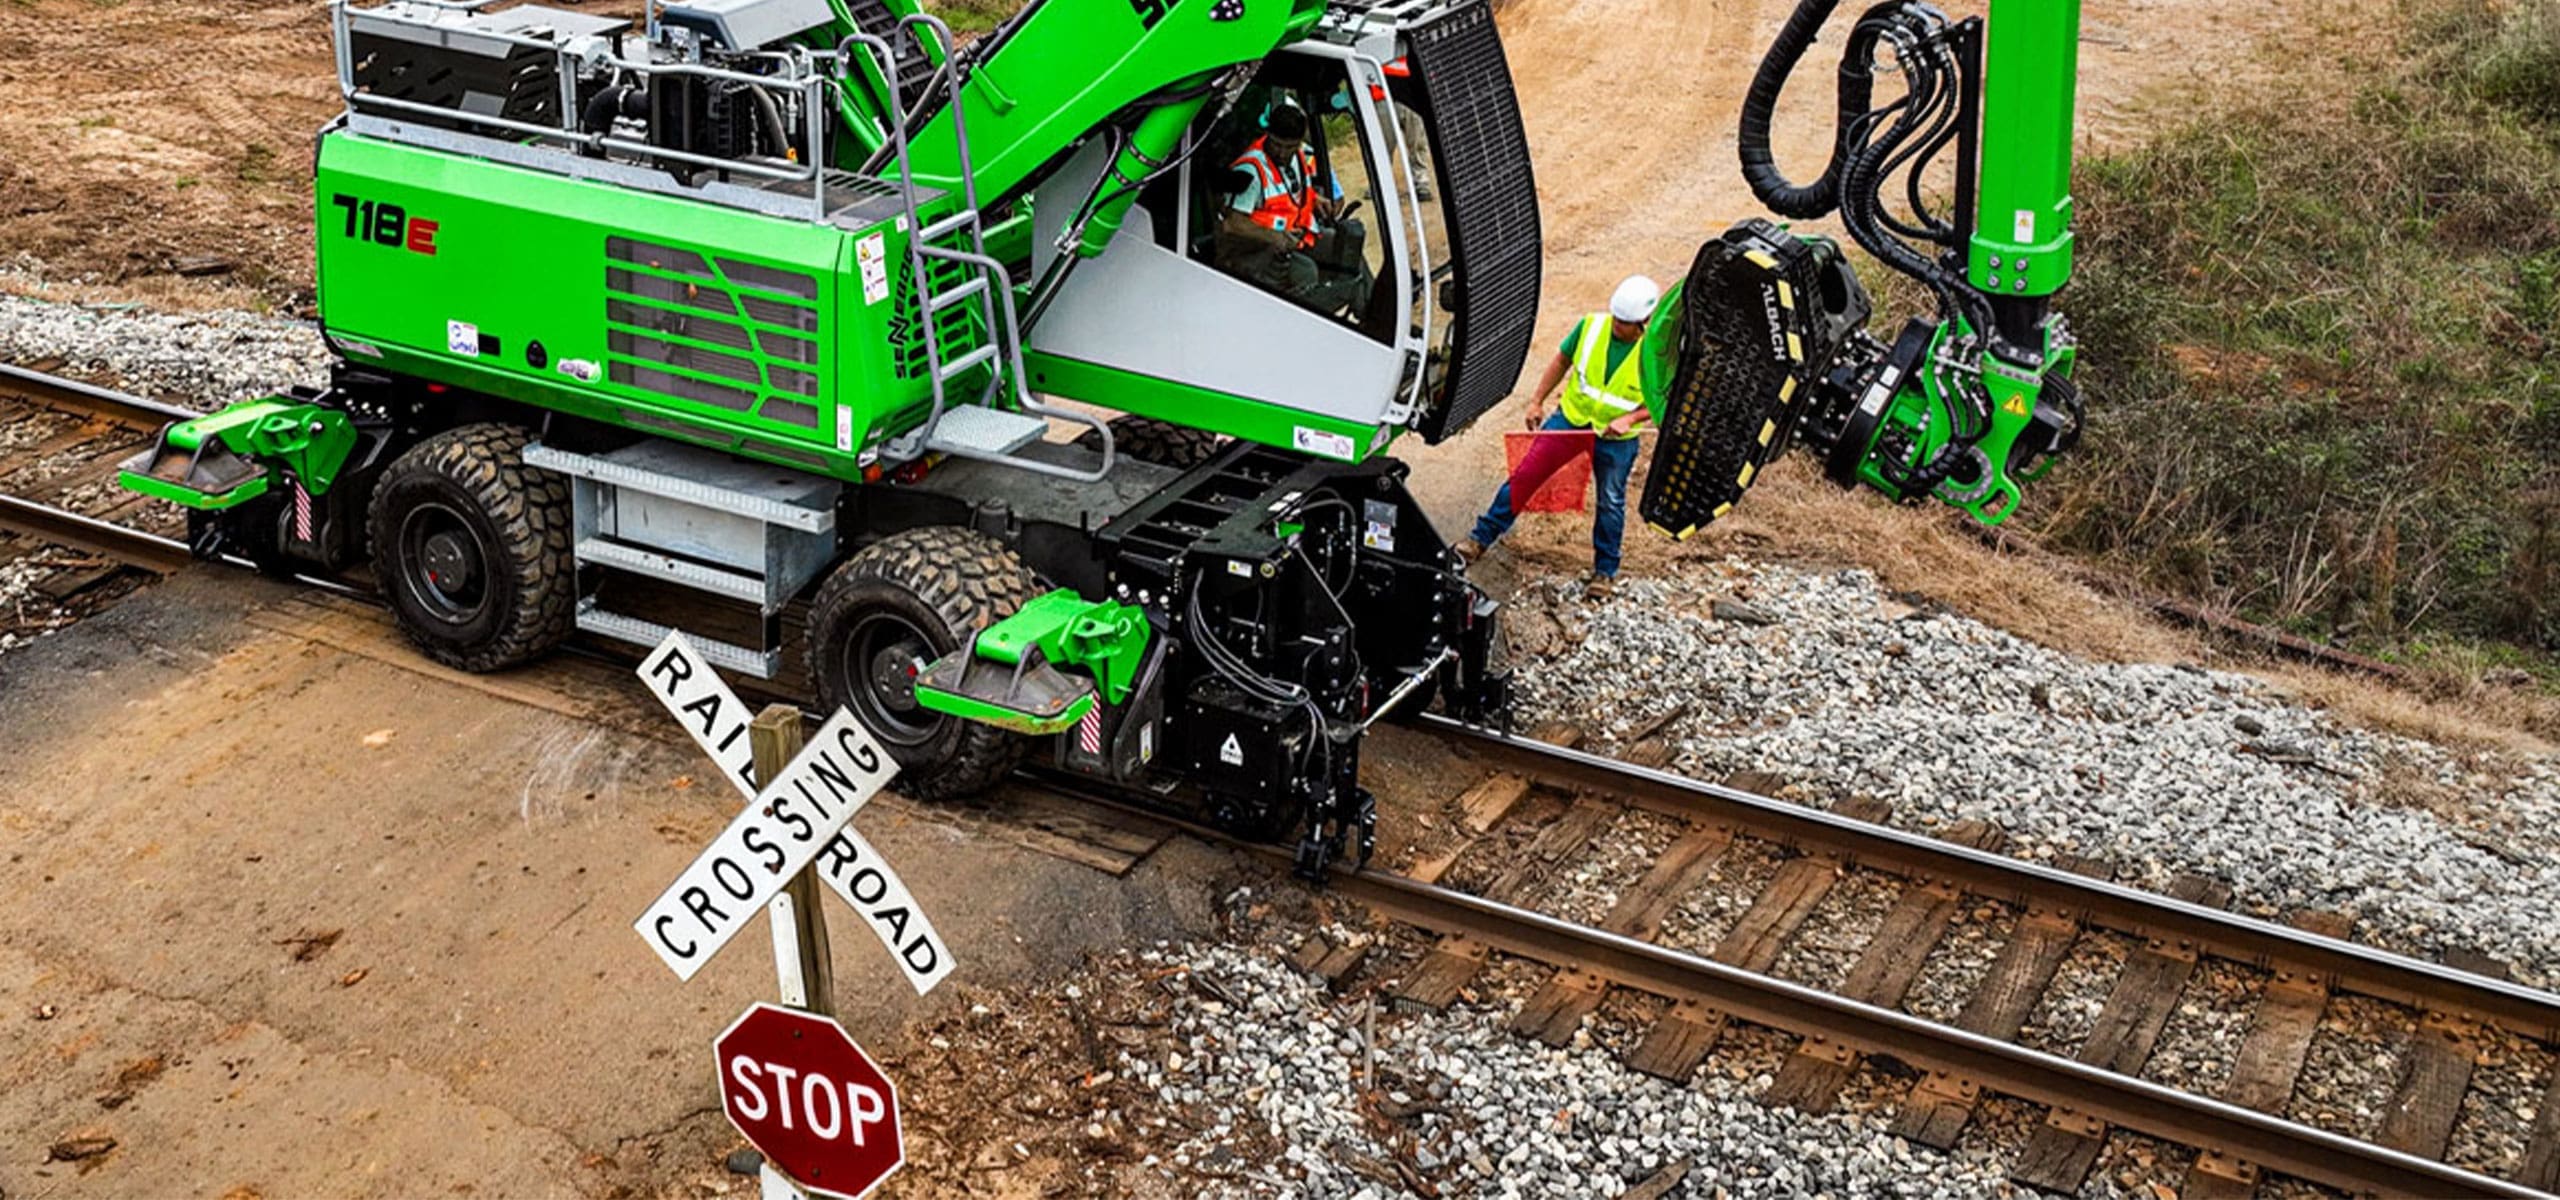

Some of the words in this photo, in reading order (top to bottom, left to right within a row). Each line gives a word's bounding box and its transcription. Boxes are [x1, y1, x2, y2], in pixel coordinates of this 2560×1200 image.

[333, 193, 439, 256] 718E
[1760, 282, 1787, 361] ALBACH
[655, 726, 880, 959] CROSSING
[816, 832, 938, 975] ROAD
[730, 1055, 885, 1146] STOP
